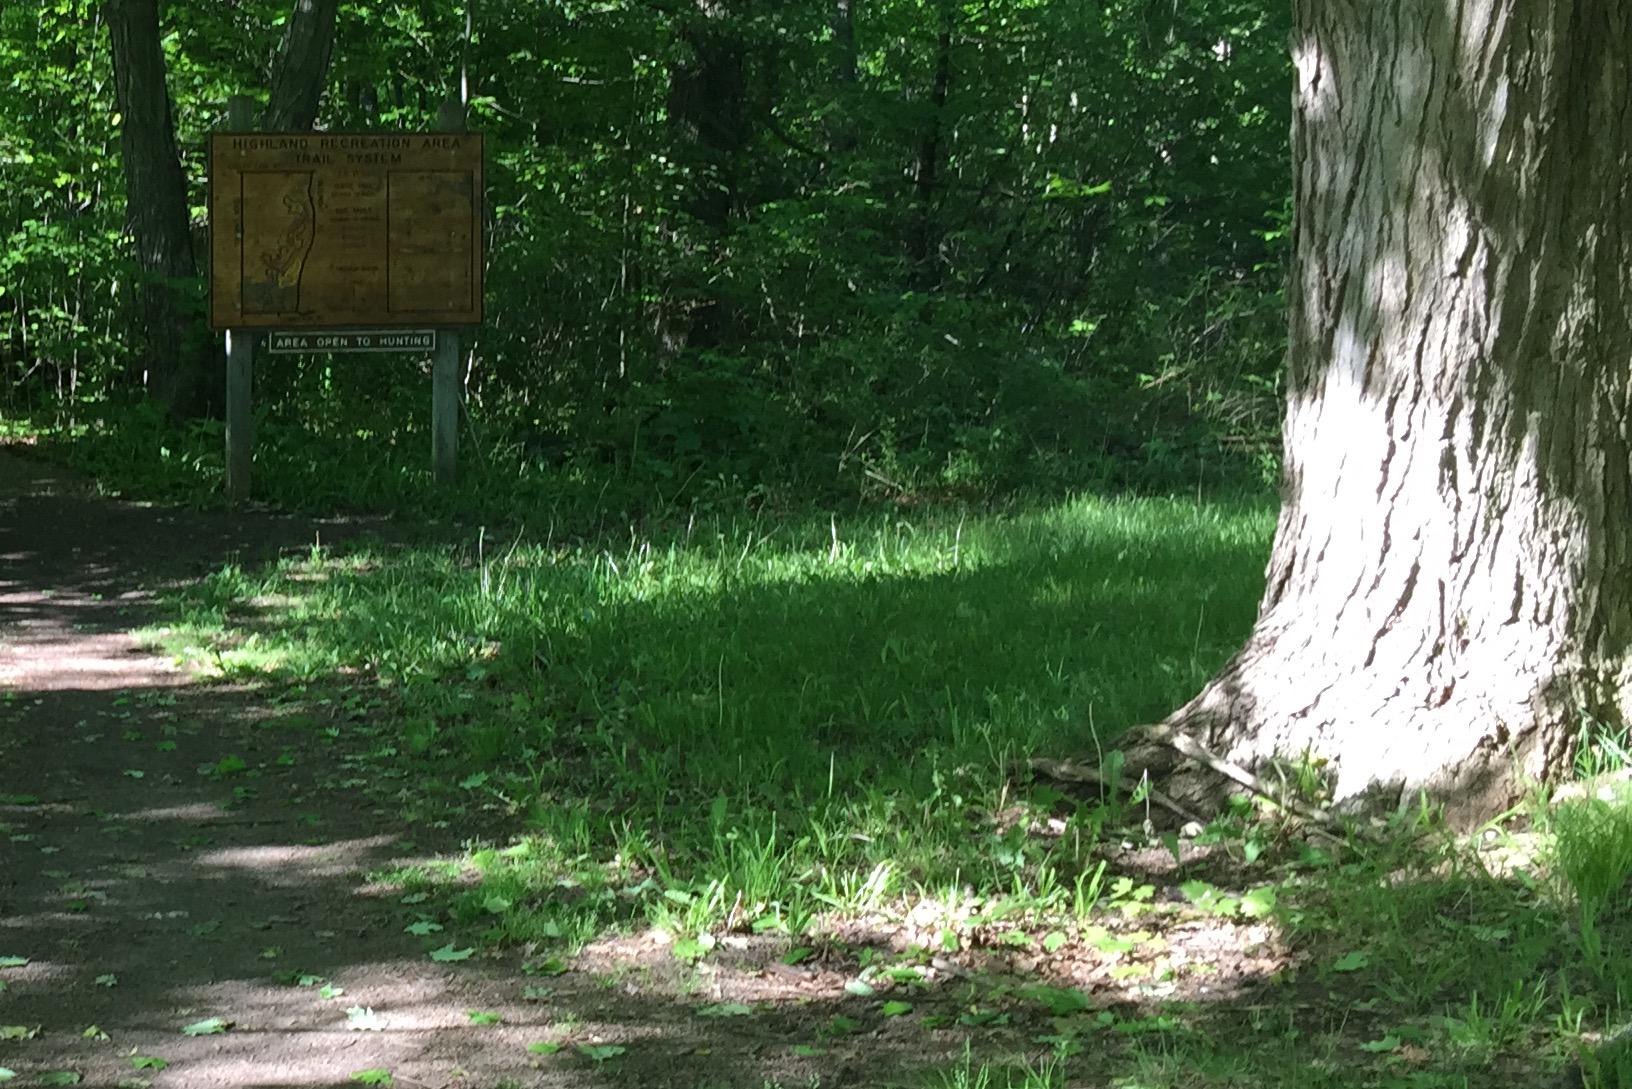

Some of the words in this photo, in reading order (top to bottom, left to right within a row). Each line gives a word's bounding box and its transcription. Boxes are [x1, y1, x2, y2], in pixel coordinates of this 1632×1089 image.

[232, 138, 308, 149] HIGHLAND
[320, 138, 410, 149] RECREATION
[422, 137, 461, 149] AREA
[296, 153, 333, 165] TRAIL
[347, 153, 402, 165] SYSTEM
[276, 338, 308, 348] AREA
[316, 338, 348, 348] OPEN
[357, 336, 371, 347] TO
[378, 336, 431, 347] HUNTING
